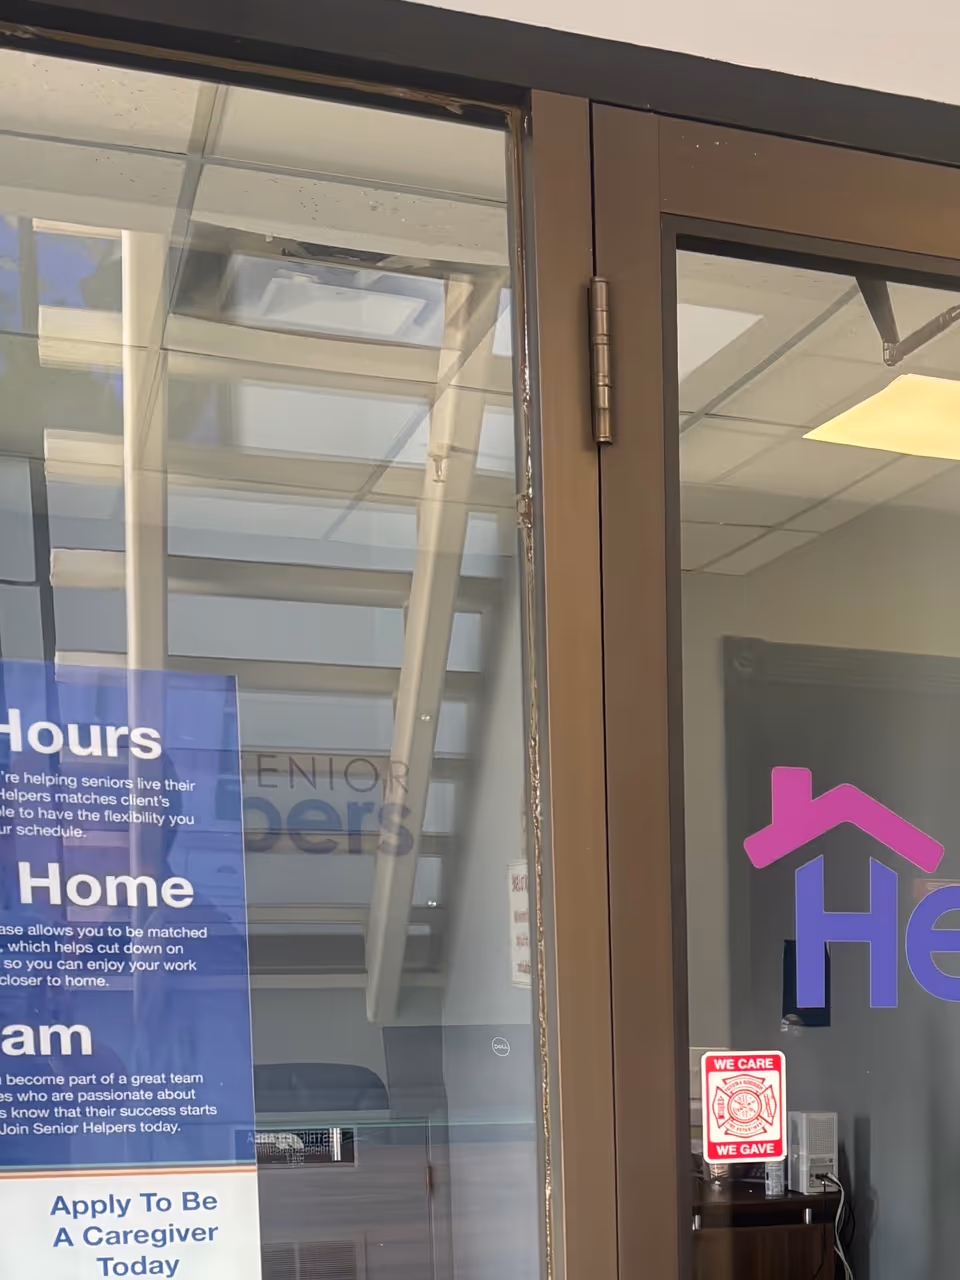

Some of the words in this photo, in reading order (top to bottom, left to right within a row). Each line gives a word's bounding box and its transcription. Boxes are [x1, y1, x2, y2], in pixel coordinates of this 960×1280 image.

[241, 753, 408, 794] ENIOR
[24, 772, 77, 788] helping
[81, 776, 134, 789] seniors
[137, 777, 161, 790] live
[164, 779, 196, 791] their
[55, 792, 117, 805] matches
[121, 794, 170, 807] client's
[19, 808, 34, 819] to
[38, 807, 73, 820] have
[77, 809, 100, 821] the
[104, 810, 165, 826] flexibility
[169, 815, 195, 827] you
[16, 825, 87, 838] schedule.
[18, 861, 194, 908] Home
[28, 924, 73, 936] allows
[77, 927, 103, 939] you
[108, 927, 121, 938] to
[126, 926, 143, 938] be
[148, 927, 207, 939] matched
[7, 940, 50, 953] which
[54, 941, 93, 956] helps
[97, 942, 119, 954] cut
[123, 942, 162, 954] down
[166, 945, 183, 954] on
[3, 959, 22, 969] so
[26, 959, 52, 971] you
[57, 960, 83, 969] can
[87, 958, 124, 972] enjoy
[128, 961, 160, 973] your
[163, 959, 196, 971] work
[0, 975, 42, 986] closer
[47, 975, 61, 986] to
[65, 975, 109, 987] home.
[1, 1023, 92, 1056] am
[714, 1058, 735, 1070] WE
[738, 1058, 774, 1069] CARE
[6, 1073, 65, 1085] become
[69, 1074, 97, 1087] part
[100, 1073, 115, 1085] of
[118, 1074, 127, 1084] a
[131, 1073, 166, 1087] great
[170, 1073, 203, 1084] team
[17, 1090, 48, 1101] who
[51, 1091, 73, 1101] are
[78, 1089, 153, 1103] passionate
[157, 1089, 196, 1100] about
[11, 1107, 49, 1118] know
[54, 1106, 81, 1117] that
[85, 1105, 115, 1117] their
[120, 1106, 176, 1116] success
[180, 1104, 217, 1115] starts
[0, 1123, 29, 1135] Join
[33, 1122, 79, 1134] Senior
[83, 1122, 136, 1135] Helpers
[140, 1121, 181, 1134] today.
[716, 1145, 737, 1156] WE
[740, 1143, 775, 1155] GAVE
[50, 1193, 131, 1219] Apply
[139, 1192, 172, 1212] To
[182, 1191, 218, 1211] Be
[53, 1227, 74, 1247] A
[83, 1223, 218, 1248] Caregiver
[97, 1255, 180, 1278] Today
